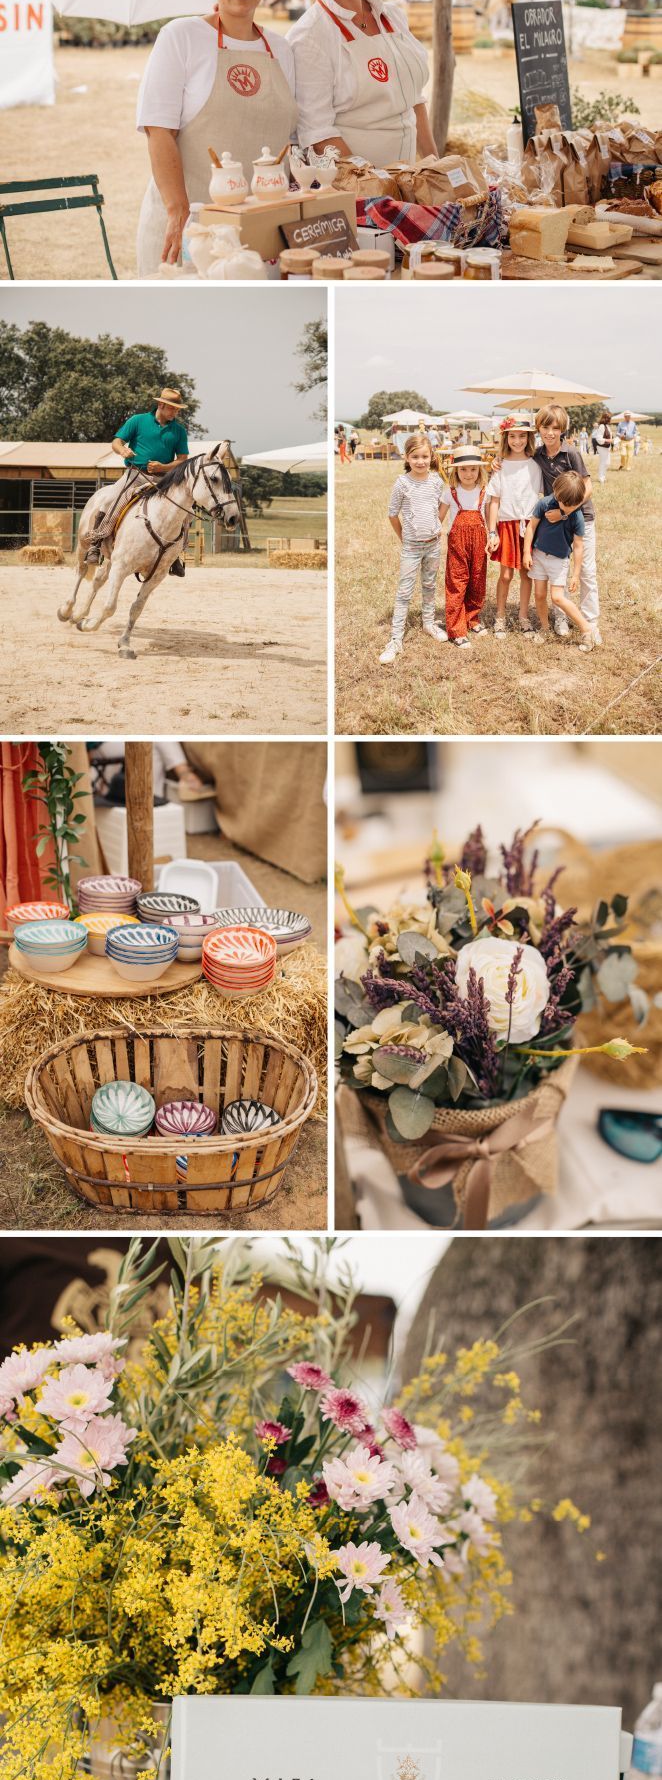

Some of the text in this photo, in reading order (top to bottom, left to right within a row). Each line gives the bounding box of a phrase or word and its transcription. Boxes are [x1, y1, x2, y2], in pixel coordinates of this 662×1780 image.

[524, 7, 557, 27] OBRADOR
[520, 28, 563, 49] EL MILAGRO
[293, 218, 347, 243] CERÁMICA
